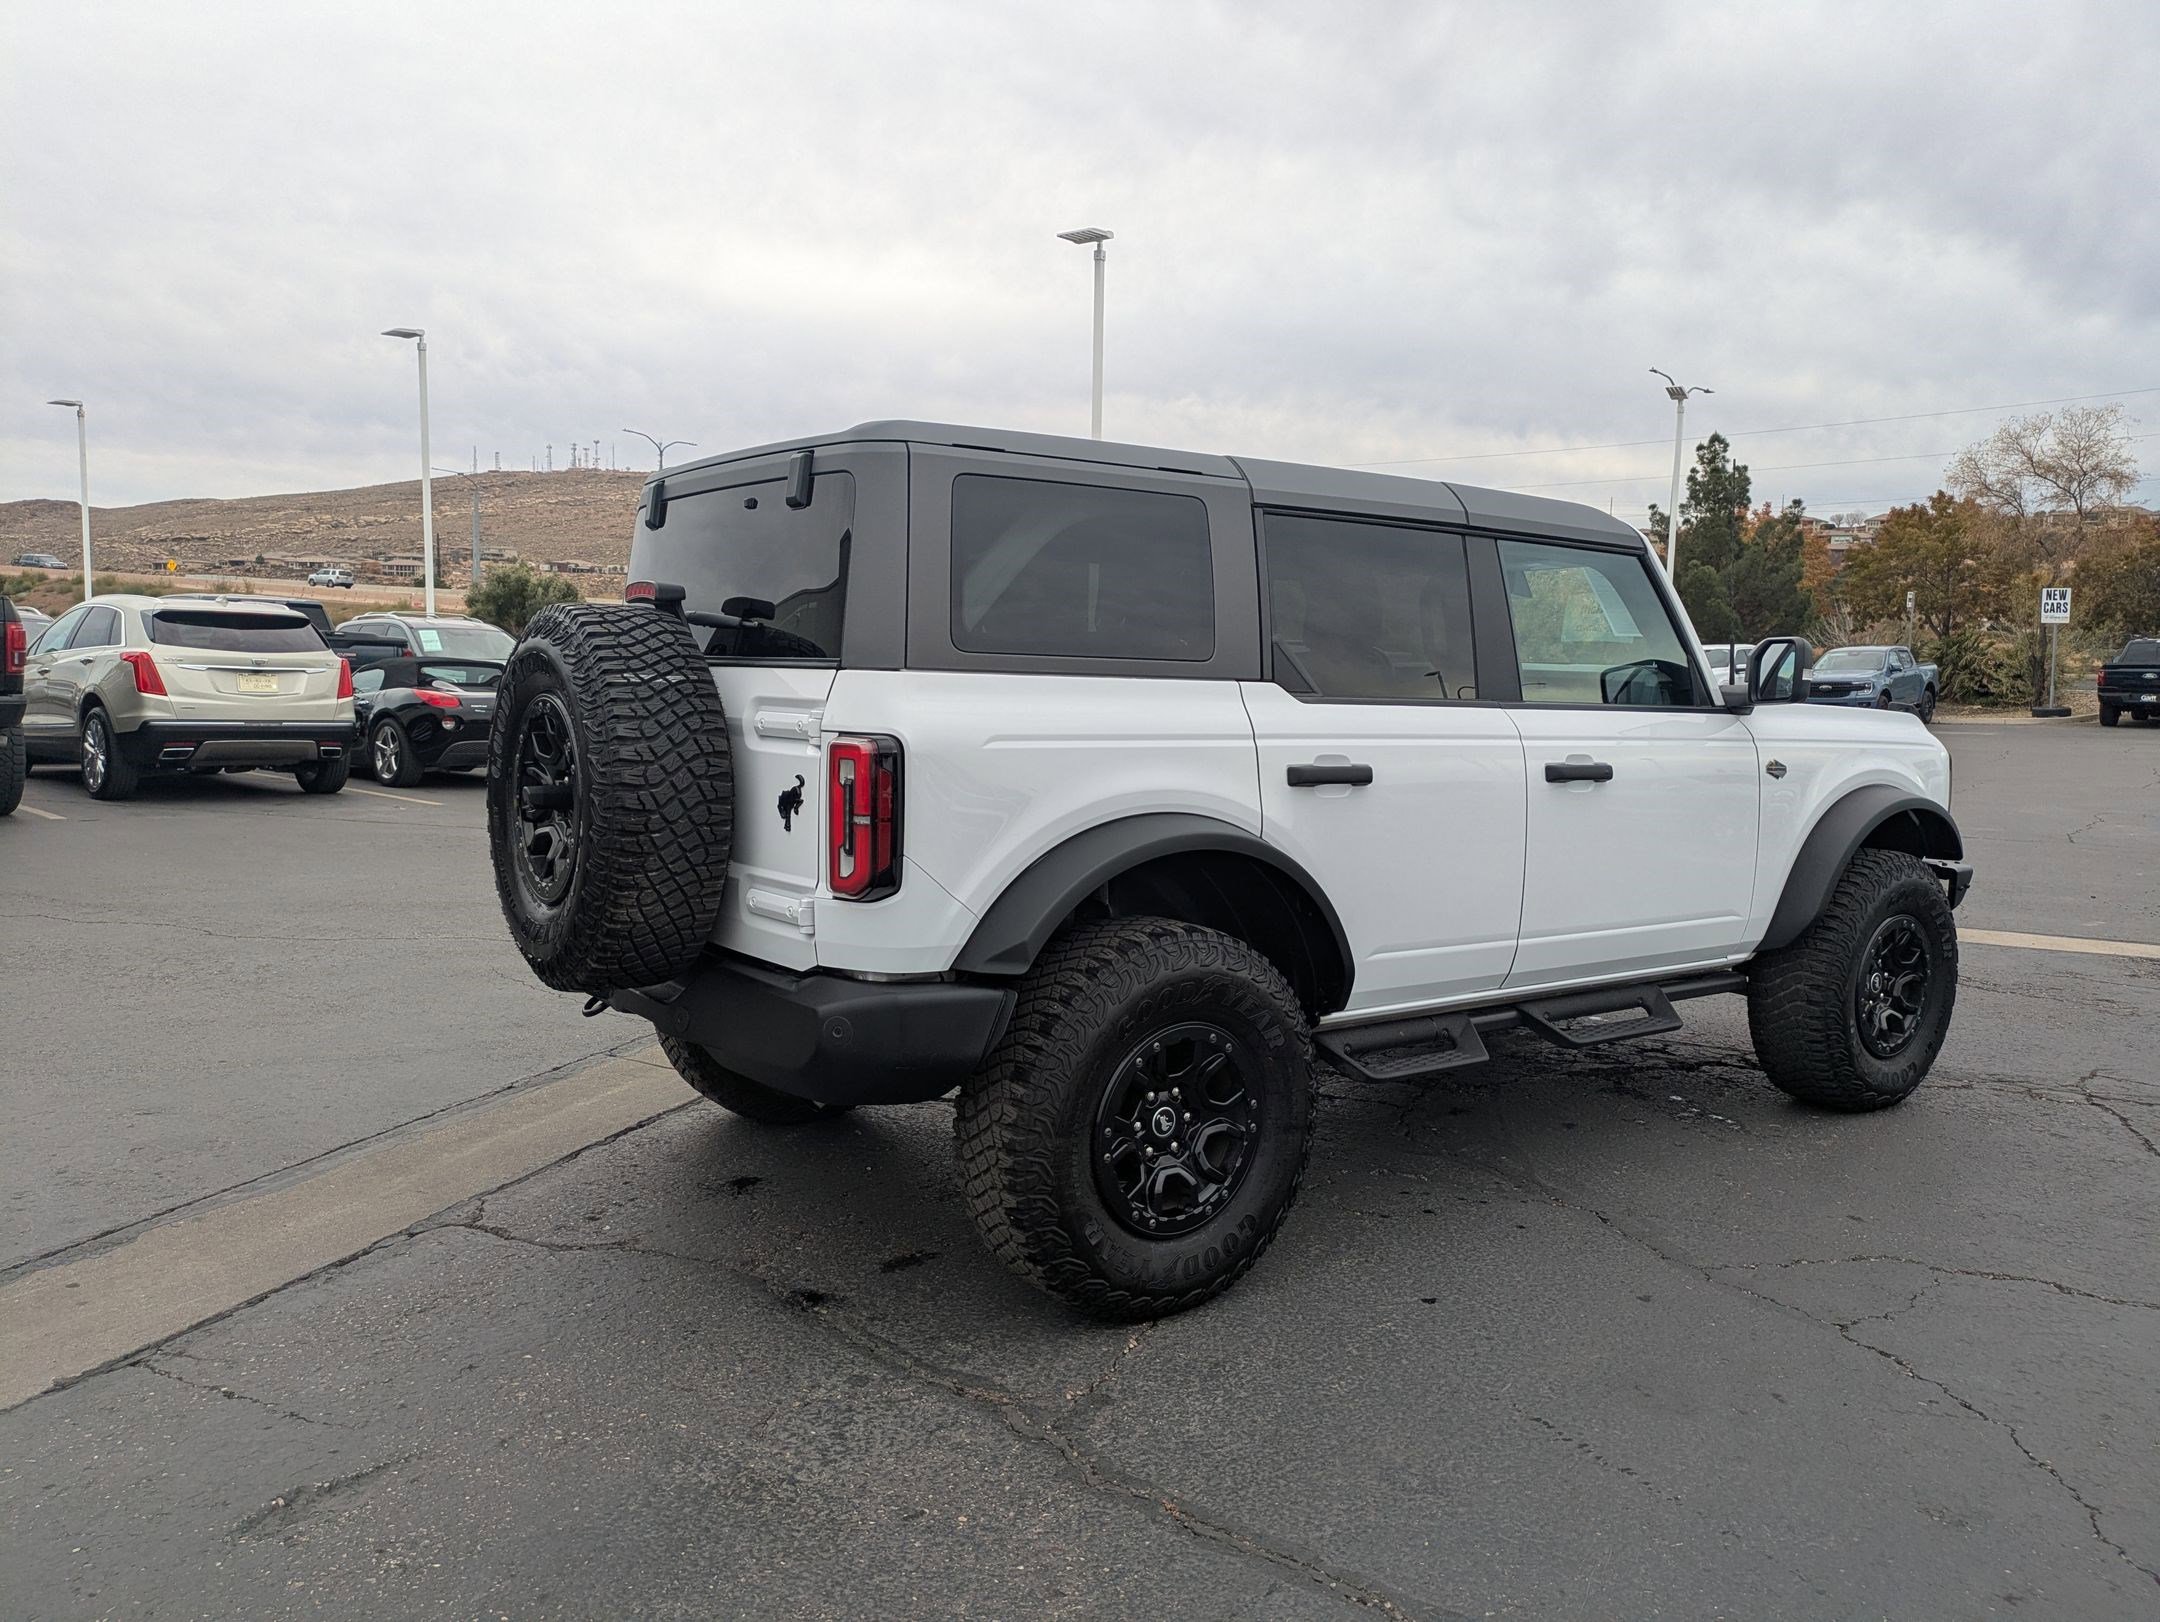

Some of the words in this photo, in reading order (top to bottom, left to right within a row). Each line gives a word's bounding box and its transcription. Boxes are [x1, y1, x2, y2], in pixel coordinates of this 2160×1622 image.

[2046, 589, 2067, 600] NEW
[2043, 602, 2068, 613] CARS
[1117, 975, 1287, 1050] GOODYEAR
